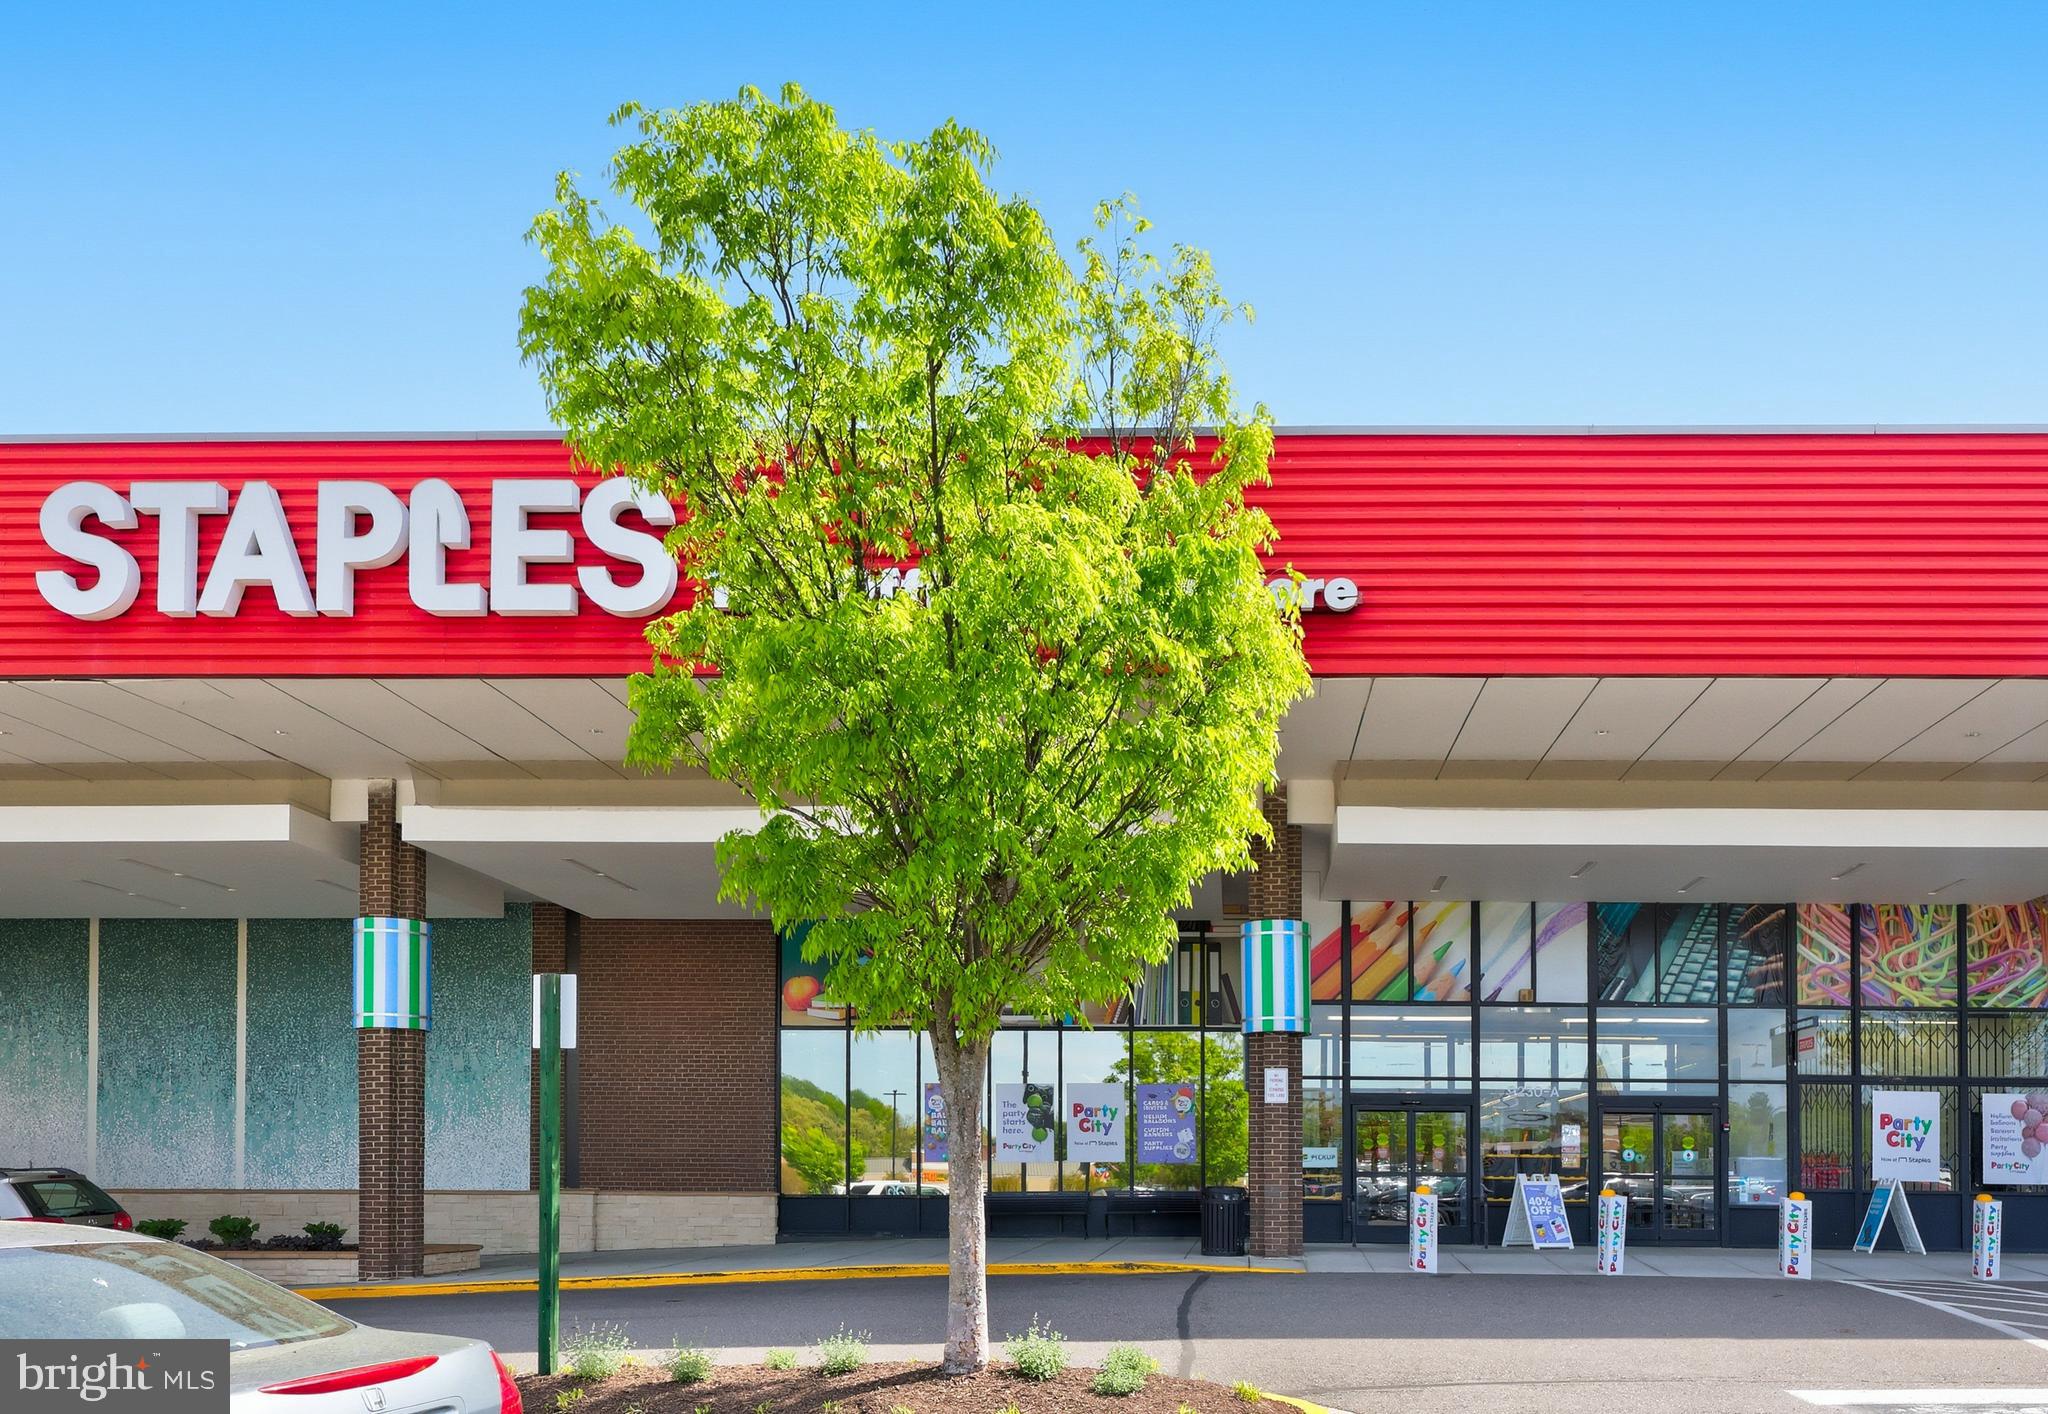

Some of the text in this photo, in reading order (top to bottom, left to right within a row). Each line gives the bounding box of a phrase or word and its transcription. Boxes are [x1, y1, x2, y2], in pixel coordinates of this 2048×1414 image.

[35, 476, 678, 620] STAPLES
[1003, 1101, 1016, 1109] The
[1003, 1110, 1026, 1119] party
[1073, 1103, 1118, 1121] Party
[1079, 1118, 1112, 1136] City
[1880, 1113, 1933, 1135] Party
[1886, 1130, 1925, 1151] City
[1991, 1161, 2029, 1170] Party City
[1529, 1197, 1552, 1206] 40%
[1531, 1206, 1552, 1215] OFF
[1416, 1198, 1429, 1269] Party City
[1610, 1201, 1621, 1272] Party City
[1787, 1203, 1802, 1275] Party City
[1986, 1205, 1996, 1277] Party City
